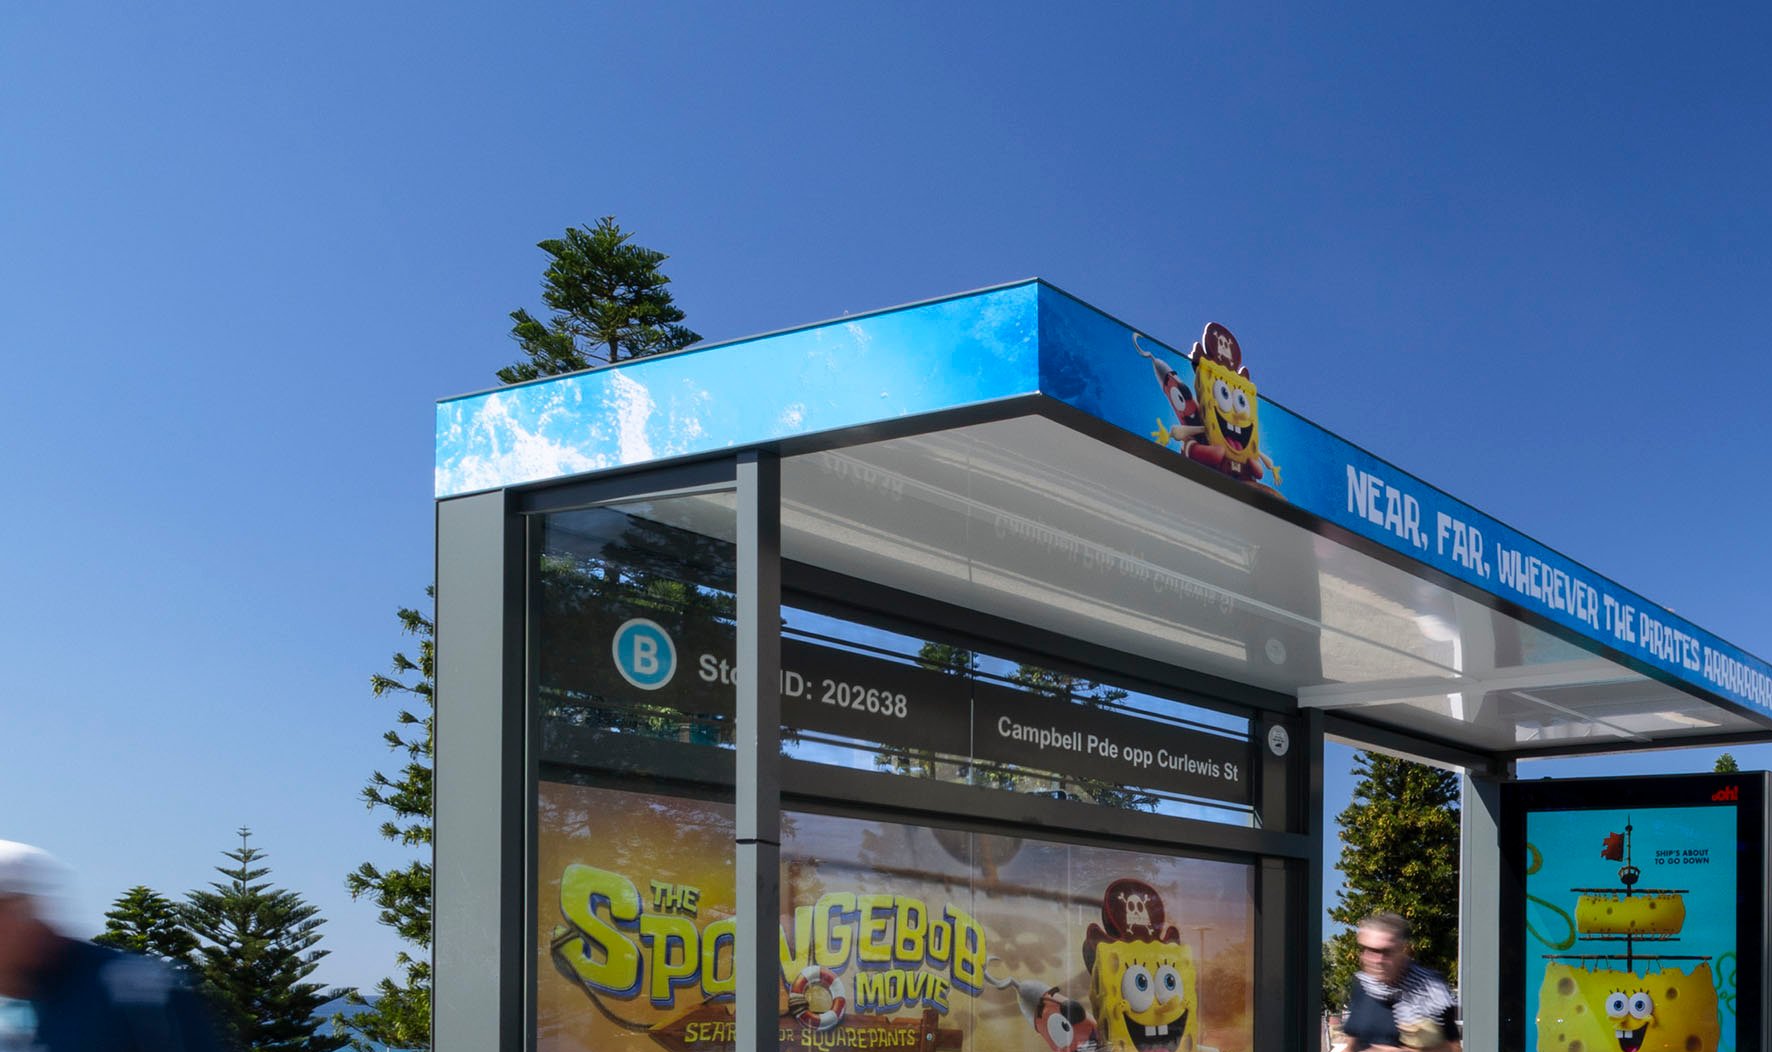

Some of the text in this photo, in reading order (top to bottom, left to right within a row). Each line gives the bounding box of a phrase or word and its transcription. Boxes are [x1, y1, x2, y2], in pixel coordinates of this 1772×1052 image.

[1346, 464, 1429, 551] NEAR,
[1437, 511, 1491, 580] FAR,
[1497, 542, 1599, 630] WHEREVER
[1603, 593, 1636, 643] THE
[633, 634, 659, 675] B
[699, 653, 908, 719] St ID: 202638
[998, 715, 1239, 782] Campbell Pde opp Curlewis St
[1655, 849, 1710, 857] SHIP'S ABOUT
[1667, 857, 1681, 865] GO
[1683, 857, 1710, 865] DOWN
[651, 879, 700, 915] THE
[552, 863, 987, 1008] SPONGEBOB
[854, 969, 950, 1015] MOVIE
[684, 1021, 917, 1052] SEAR OR SQUAREPANTS
